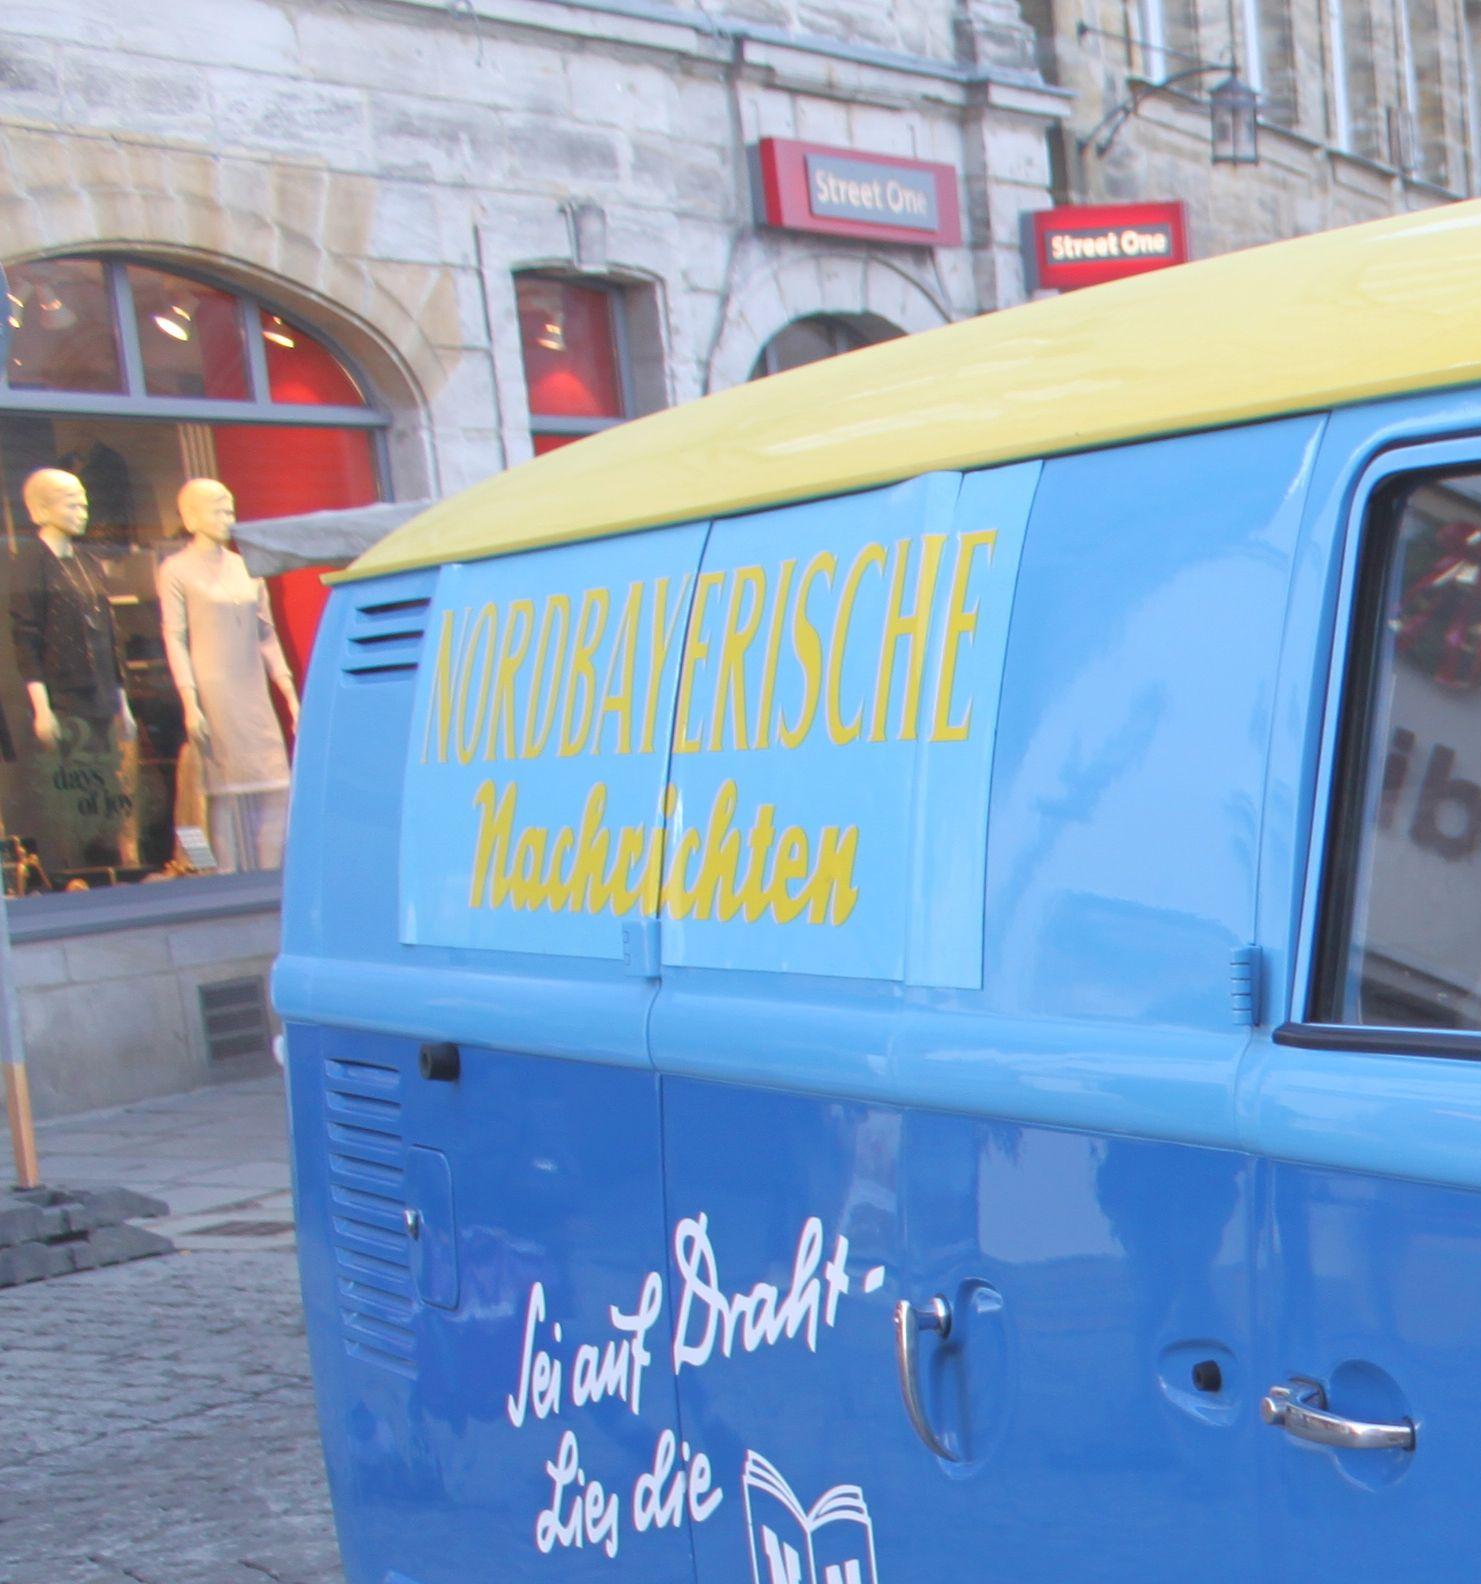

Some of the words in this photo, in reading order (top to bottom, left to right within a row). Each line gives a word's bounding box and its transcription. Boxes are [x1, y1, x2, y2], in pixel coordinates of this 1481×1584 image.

[815, 169, 884, 211] Street
[885, 179, 929, 215] One
[1051, 232, 1118, 260] Street
[1121, 229, 1167, 256] One
[421, 528, 998, 766] NORDBAYERISCHE
[469, 779, 860, 926] Nachrichten
[508, 1281, 562, 1427] Sei
[574, 1271, 662, 1415] auf
[633, 1428, 723, 1531] die
